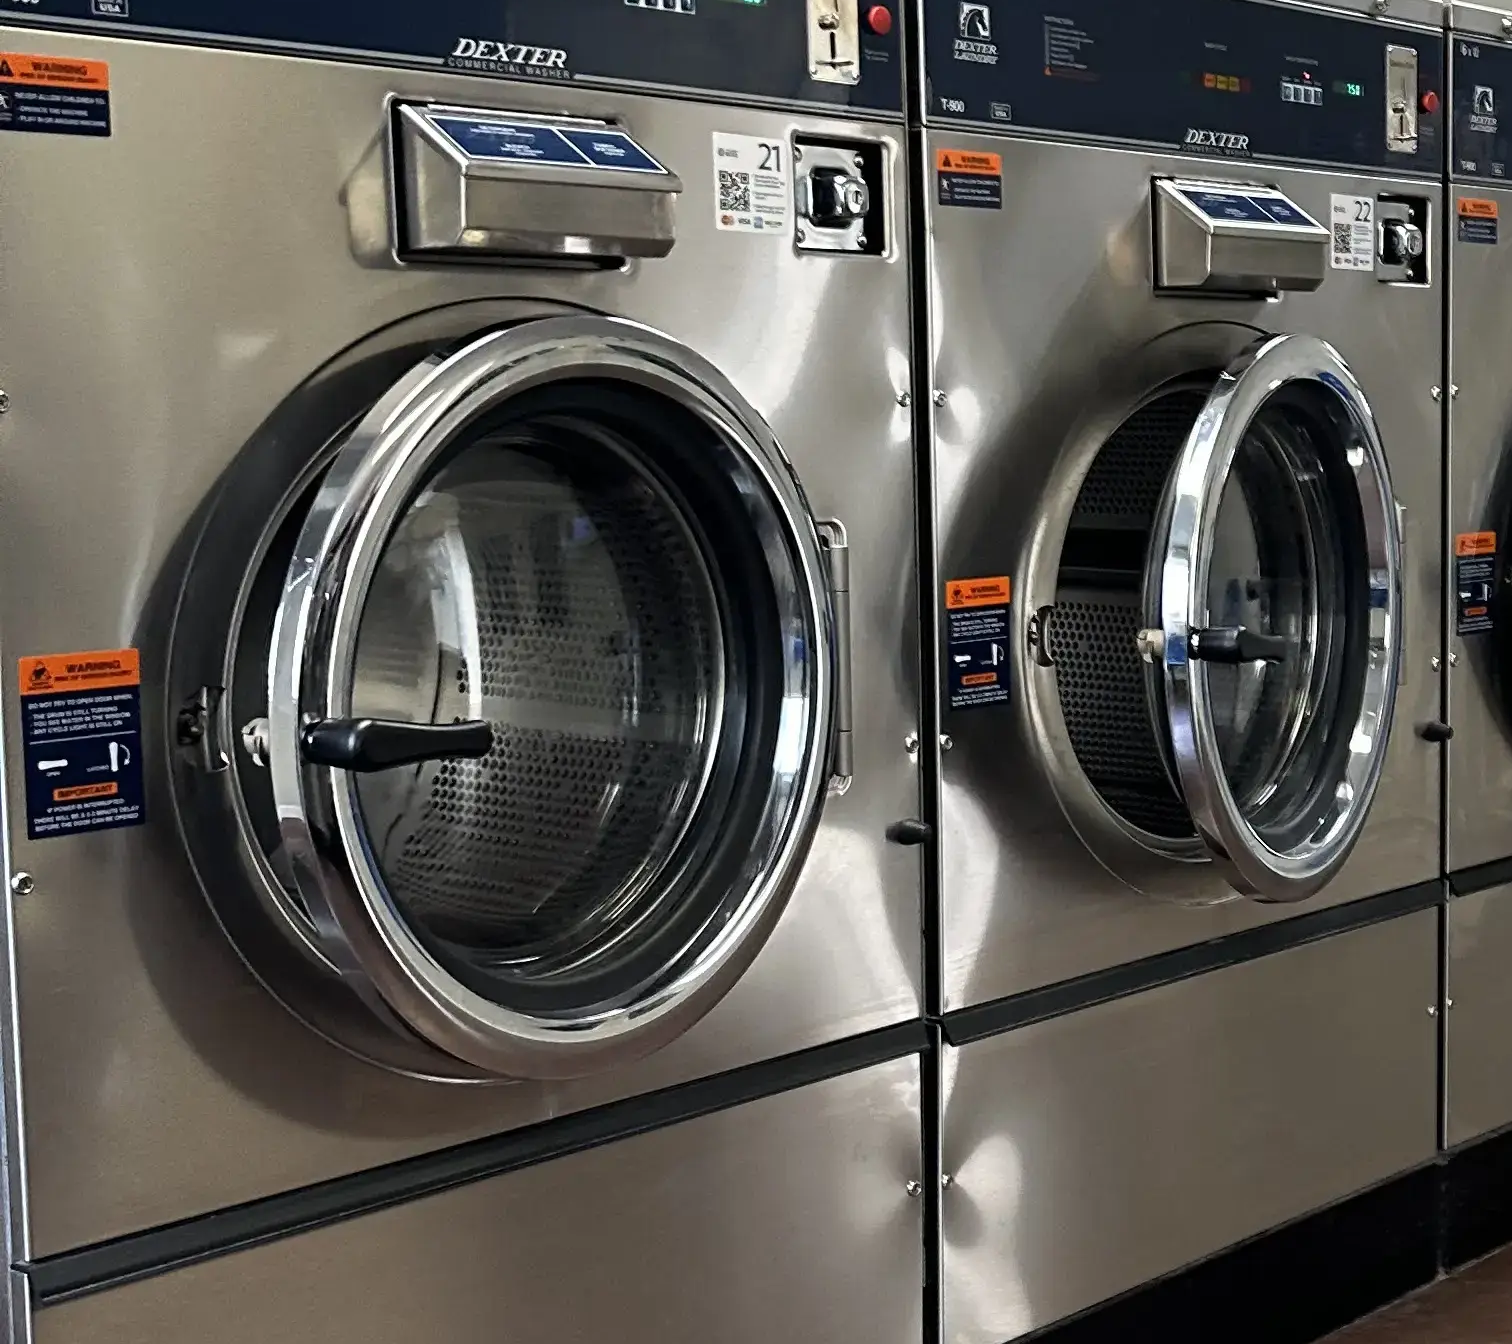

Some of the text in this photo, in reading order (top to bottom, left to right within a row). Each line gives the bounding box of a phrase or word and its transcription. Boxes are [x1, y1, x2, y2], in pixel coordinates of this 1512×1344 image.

[452, 37, 567, 68] DEXTER
[954, 39, 997, 55] DEXTER
[447, 56, 571, 79] COMMERCIAL WASHER
[1184, 127, 1249, 150] DEXTER
[758, 142, 782, 172] 21
[1354, 200, 1371, 222] 22
[65, 659, 121, 673] WARNING
